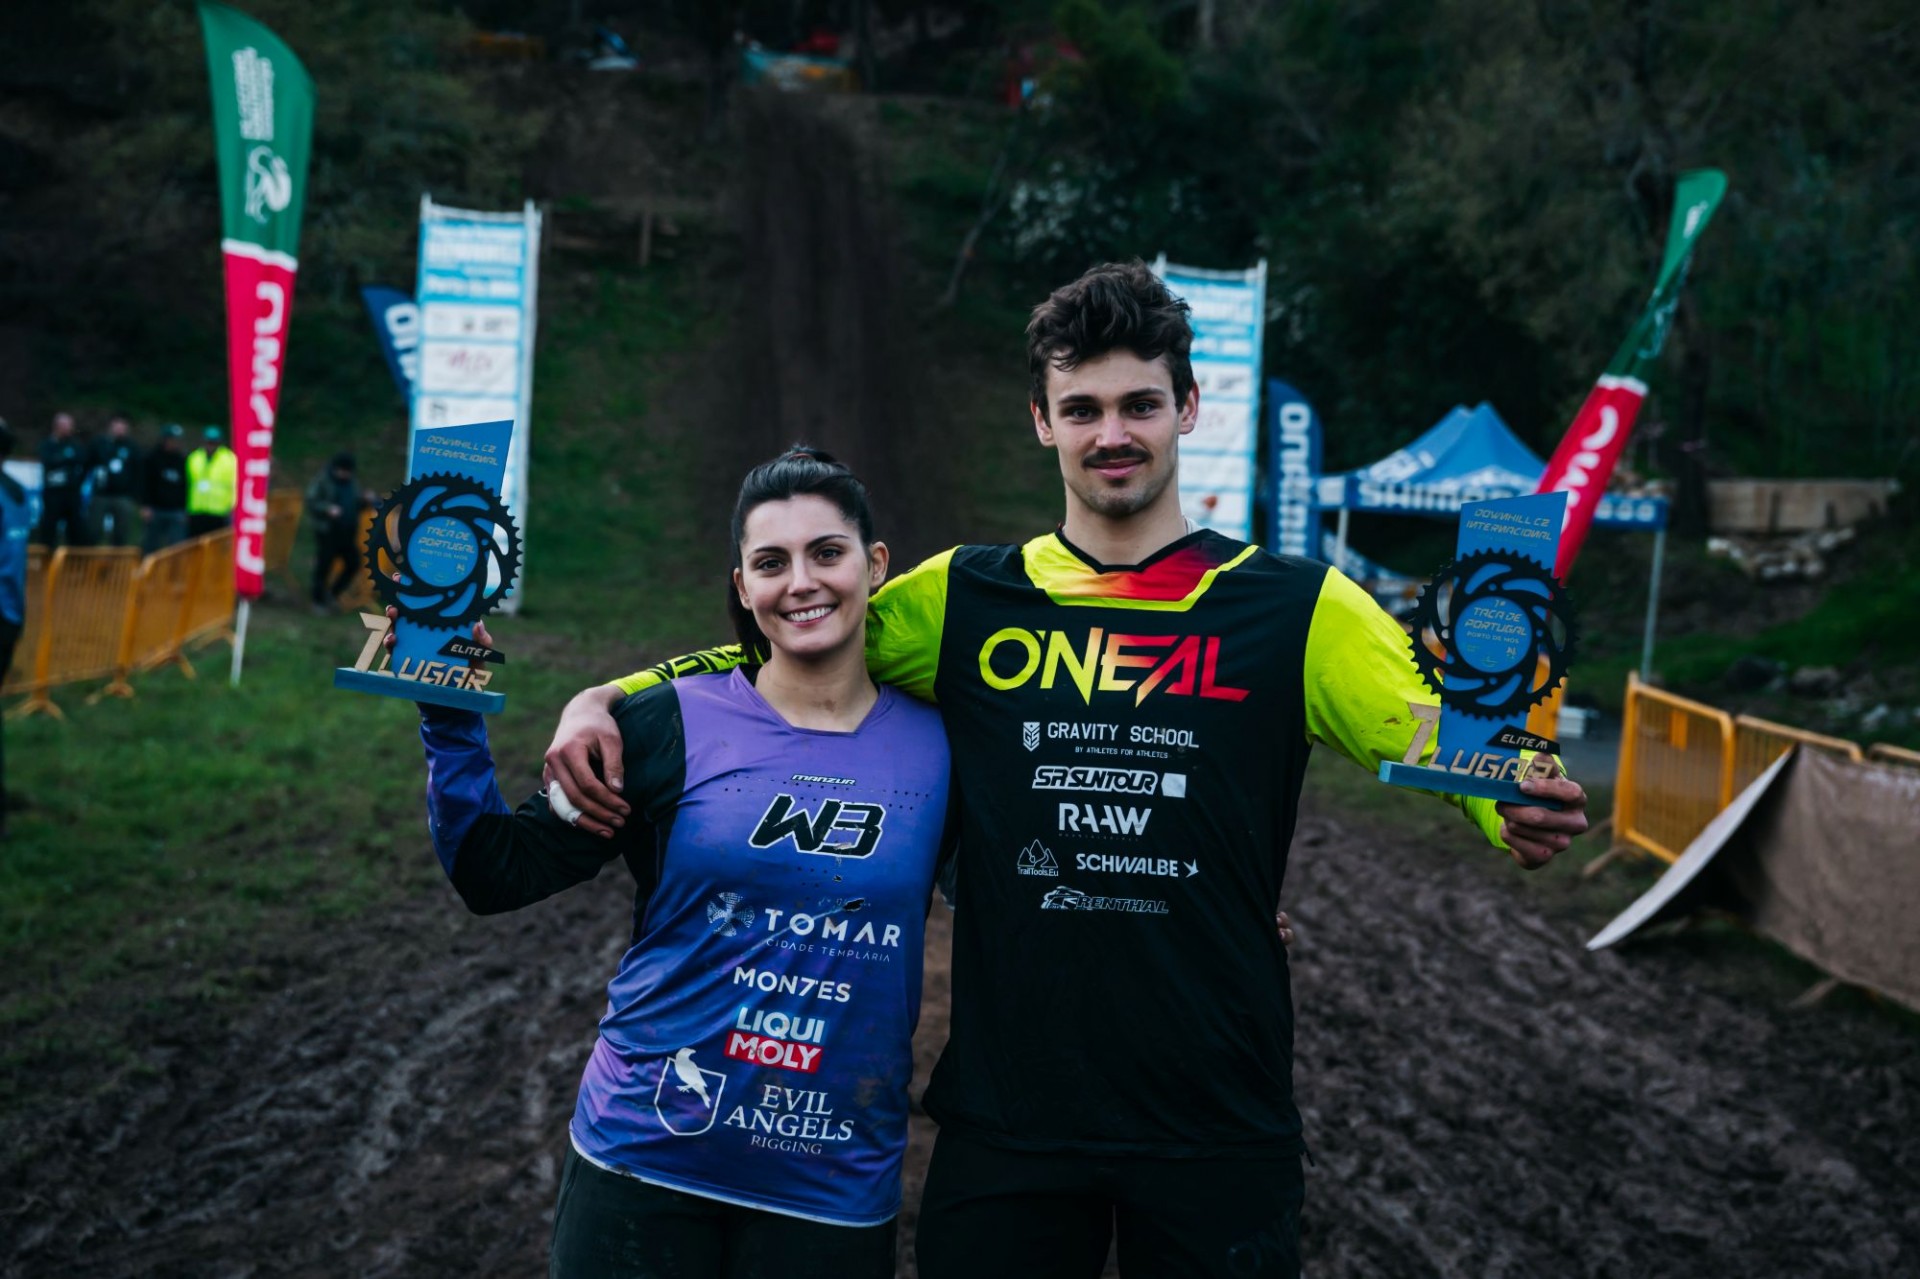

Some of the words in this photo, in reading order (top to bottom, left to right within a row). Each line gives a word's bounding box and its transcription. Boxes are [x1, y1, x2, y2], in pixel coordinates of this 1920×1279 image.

[1474, 509, 1531, 524] DOWNHILL
[1466, 521, 1552, 541] INTERNACIONAL
[418, 537, 475, 554] PORTUGAL
[1464, 619, 1527, 636] PORTUGAL
[1505, 612, 1522, 622] DE
[450, 643, 481, 657] ELITE
[482, 649, 493, 658] F
[377, 653, 494, 692] LUGAR
[1047, 721, 1119, 741] GRAVITY
[1129, 725, 1200, 749] SCHOOL
[1500, 733, 1533, 748] ELITE
[1534, 739, 1549, 750] M
[1086, 746, 1118, 755] ATHLETES
[1120, 748, 1133, 756] FOR
[1136, 750, 1168, 759] ATHLETES
[792, 774, 856, 786] MANZUR
[1067, 767, 1158, 795] SUNTOUR
[1058, 802, 1152, 836] RAAW
[1076, 853, 1178, 877] SCHWALBE
[1076, 895, 1169, 914] RENTHAL
[765, 907, 900, 947] TOMAR
[766, 938, 815, 953] CIDADE
[822, 946, 890, 962] TEMPLÁRIA
[736, 1006, 826, 1043] LIQUI
[728, 1032, 821, 1070] MOLY
[759, 1083, 833, 1115] EVIL
[723, 1105, 855, 1141] ANGELS
[750, 1134, 822, 1155] RIGGING
